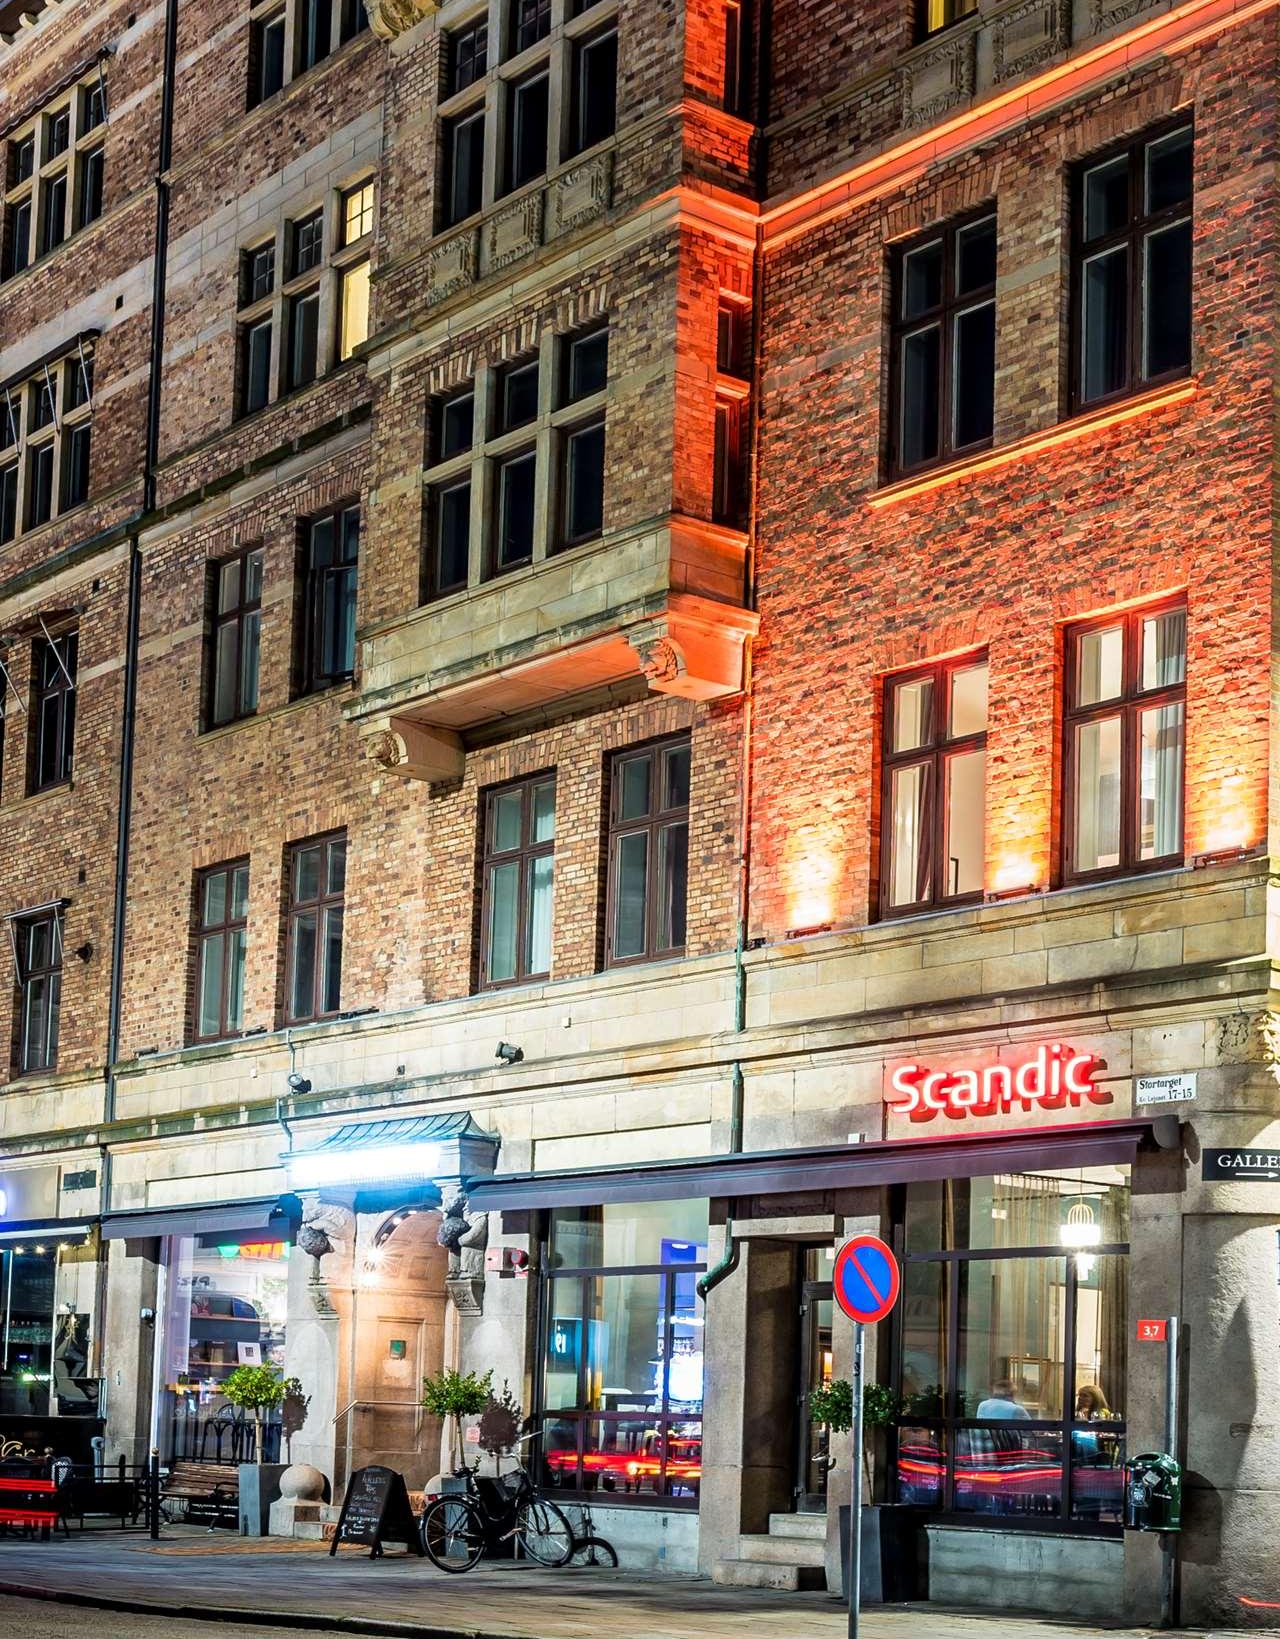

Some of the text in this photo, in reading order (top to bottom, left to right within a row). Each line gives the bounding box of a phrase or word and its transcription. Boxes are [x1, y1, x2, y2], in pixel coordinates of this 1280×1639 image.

[891, 1043, 1094, 1113] Scandic
[1168, 1088, 1193, 1100] 17-15
[1143, 1325, 1160, 1337] 3,7
